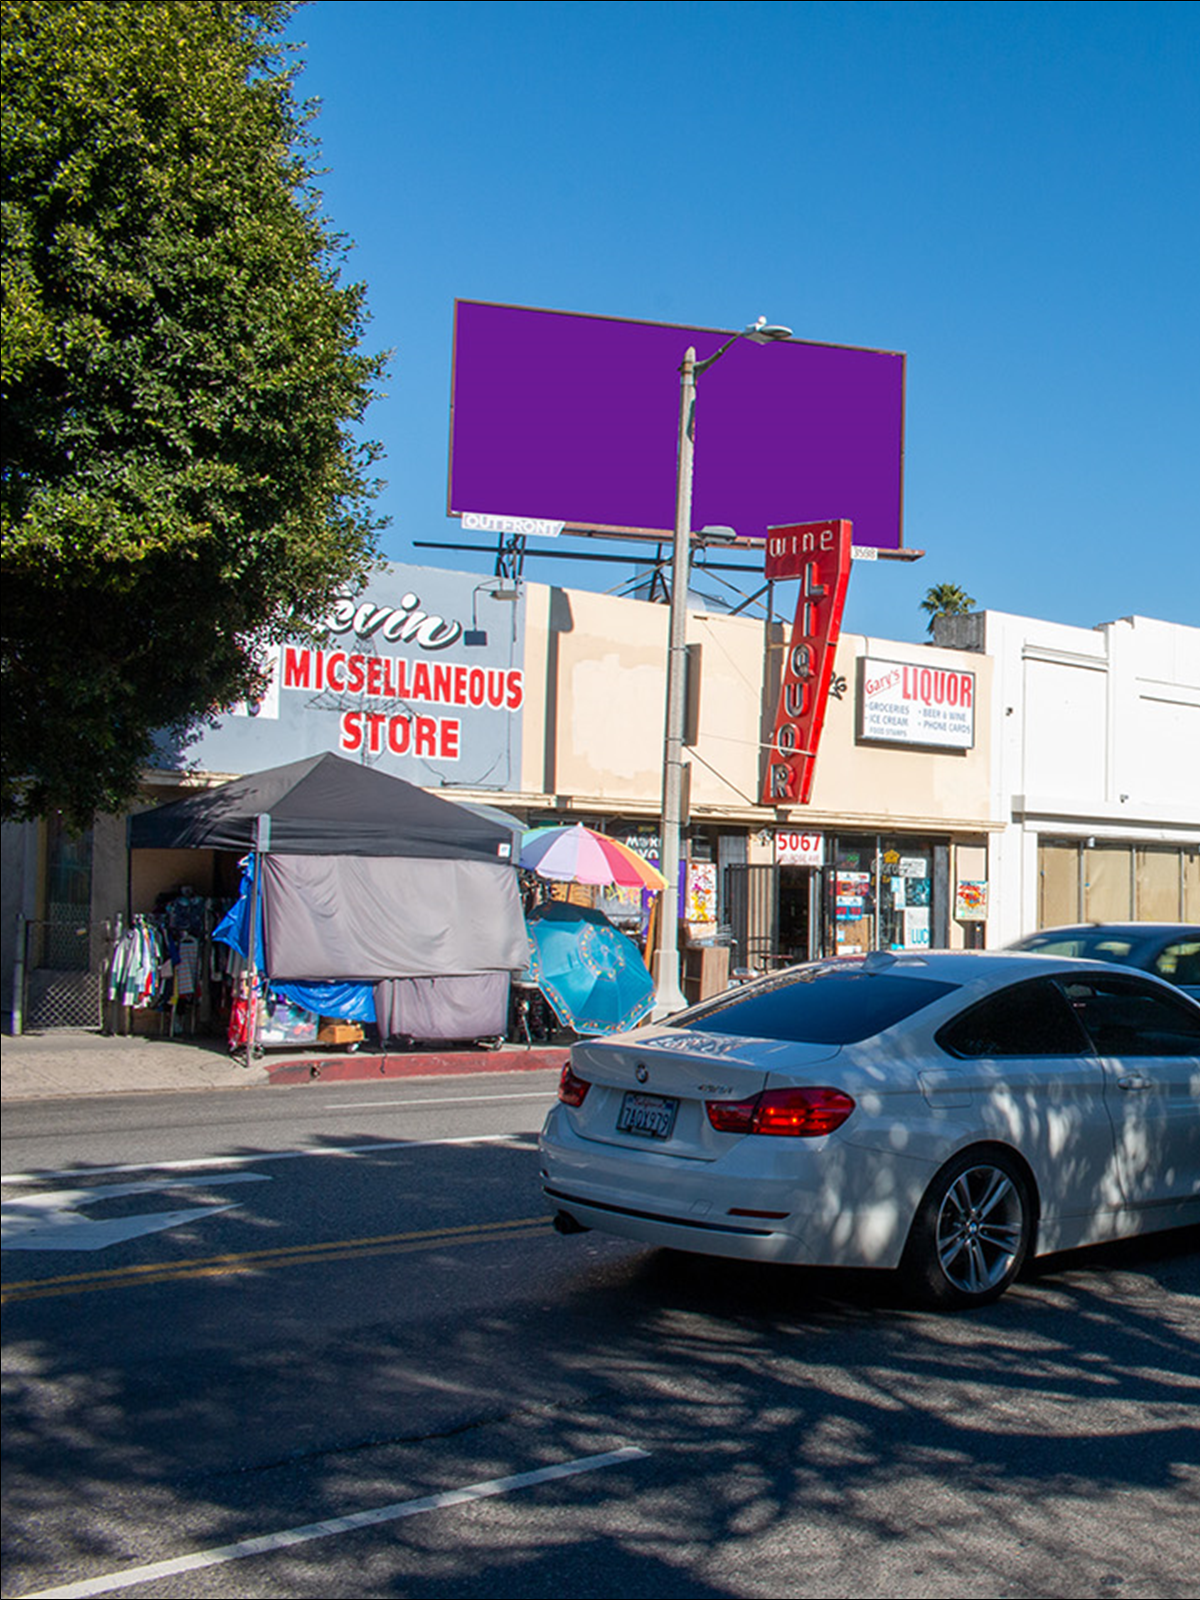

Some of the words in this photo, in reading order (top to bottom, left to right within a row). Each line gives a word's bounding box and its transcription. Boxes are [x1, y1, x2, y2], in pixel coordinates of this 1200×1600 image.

[464, 514, 561, 535] OUTFRONT
[322, 584, 461, 648] evin
[283, 647, 523, 709] MICSELLANEOUS
[770, 561, 829, 798] LIQUOR
[865, 669, 900, 695] Gary's
[902, 666, 972, 708] LIQUOR
[869, 701, 910, 715] GROCERIES
[922, 708, 941, 718] BEER
[949, 711, 966, 722] WINE
[869, 714, 880, 724] ICE
[882, 715, 909, 727] CREAM
[923, 720, 947, 731] PHONE
[949, 723, 971, 735] CARDS
[342, 711, 460, 758] STORE
[778, 832, 821, 851] 5067
